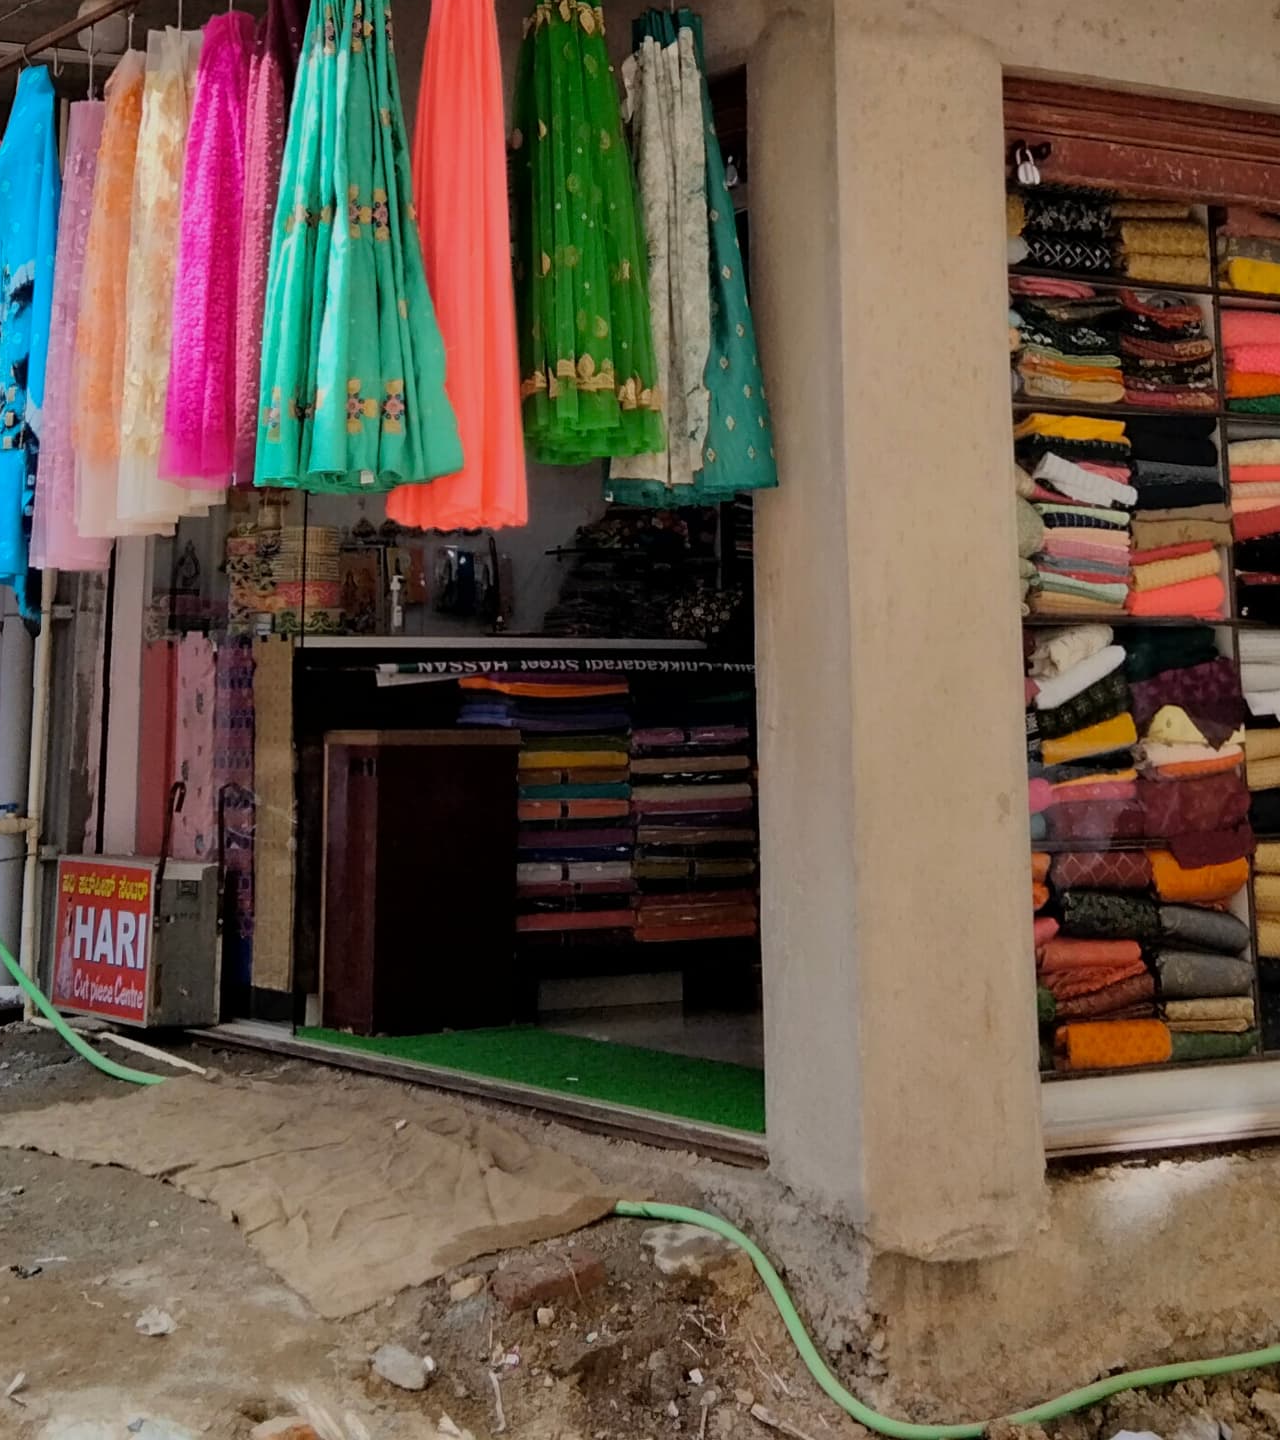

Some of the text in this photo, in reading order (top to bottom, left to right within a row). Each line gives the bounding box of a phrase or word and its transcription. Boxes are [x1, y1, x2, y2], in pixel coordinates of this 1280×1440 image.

[73, 905, 147, 970] HARI
[74, 968, 90, 1000] Cut
[114, 973, 144, 1009] Centre
